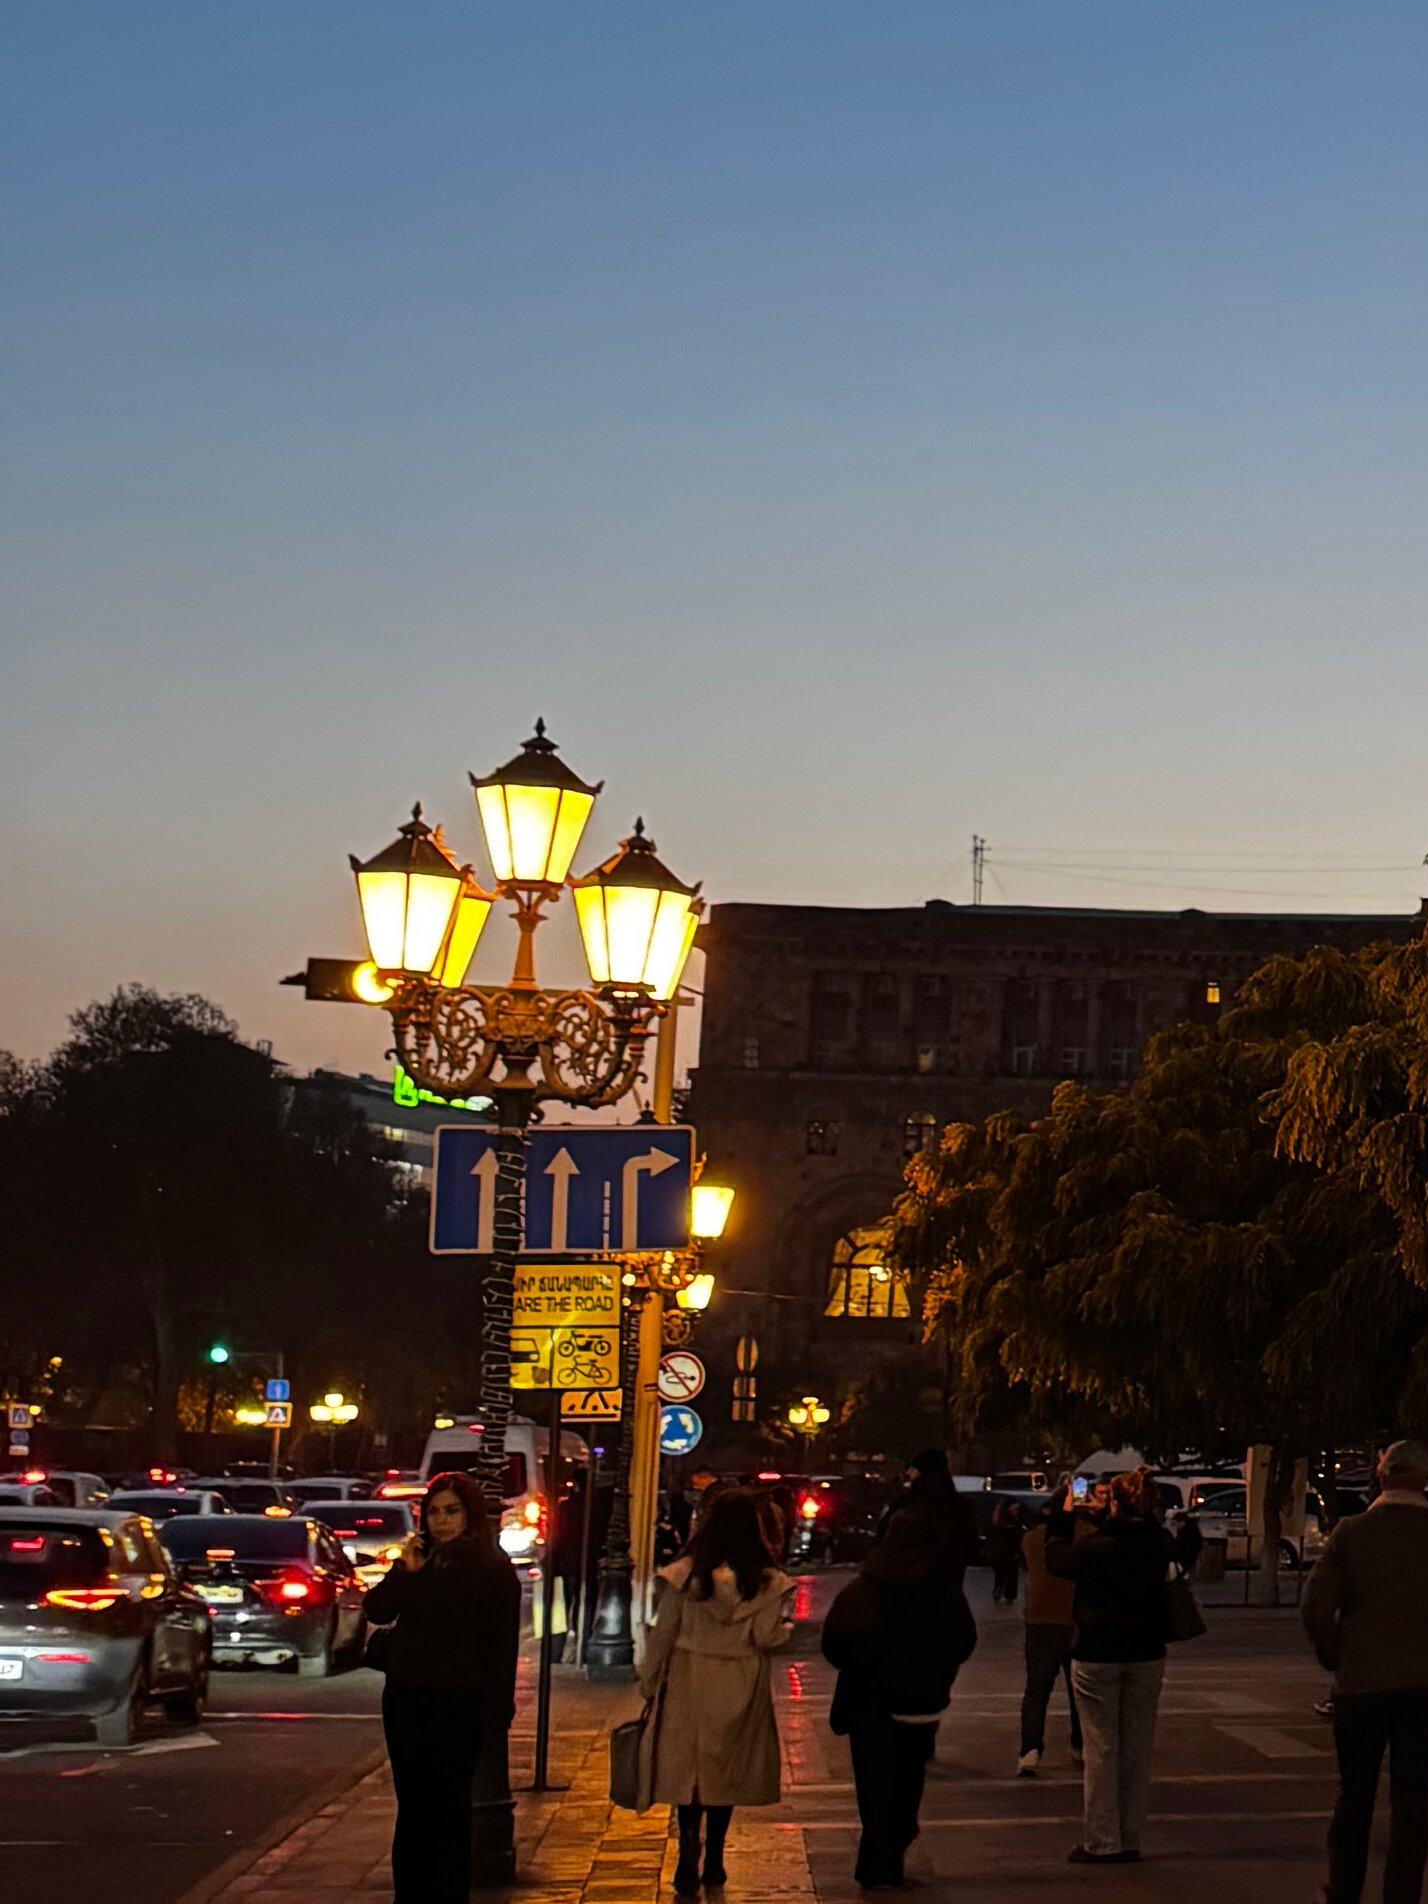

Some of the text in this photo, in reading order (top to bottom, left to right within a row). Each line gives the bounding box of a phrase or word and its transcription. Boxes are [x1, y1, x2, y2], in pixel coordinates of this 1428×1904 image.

[514, 1295, 613, 1312] ARE THE ROAD
